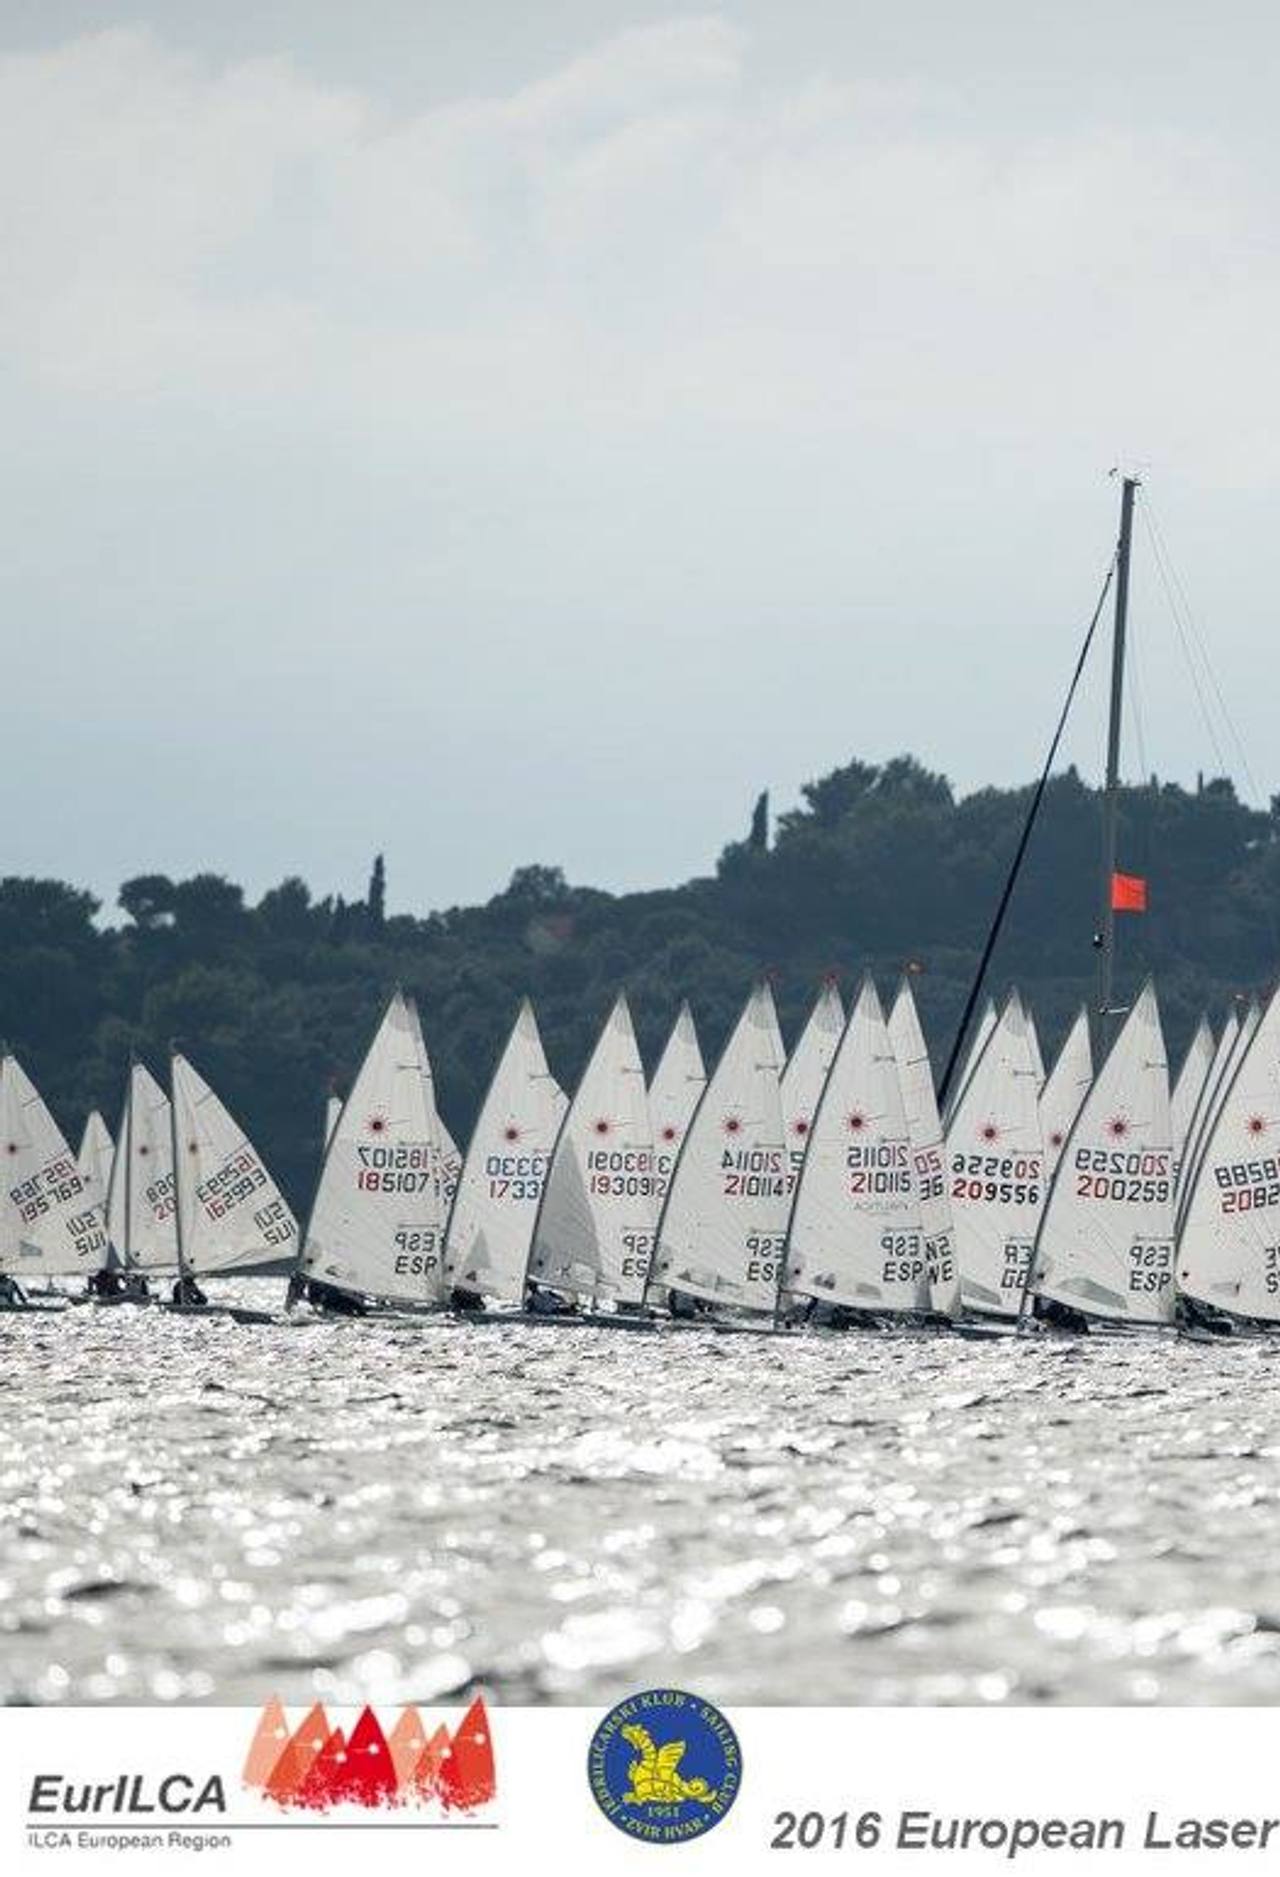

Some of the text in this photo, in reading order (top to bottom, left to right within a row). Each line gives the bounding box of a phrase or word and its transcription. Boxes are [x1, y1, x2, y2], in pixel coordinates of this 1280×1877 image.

[358, 1171, 431, 1193] 185107
[952, 1178, 1039, 1205] 209556
[1077, 1175, 1170, 1203] 200259
[394, 1255, 438, 1276] ESP
[882, 1260, 924, 1282] ESP
[1129, 1270, 1172, 1292] ESP
